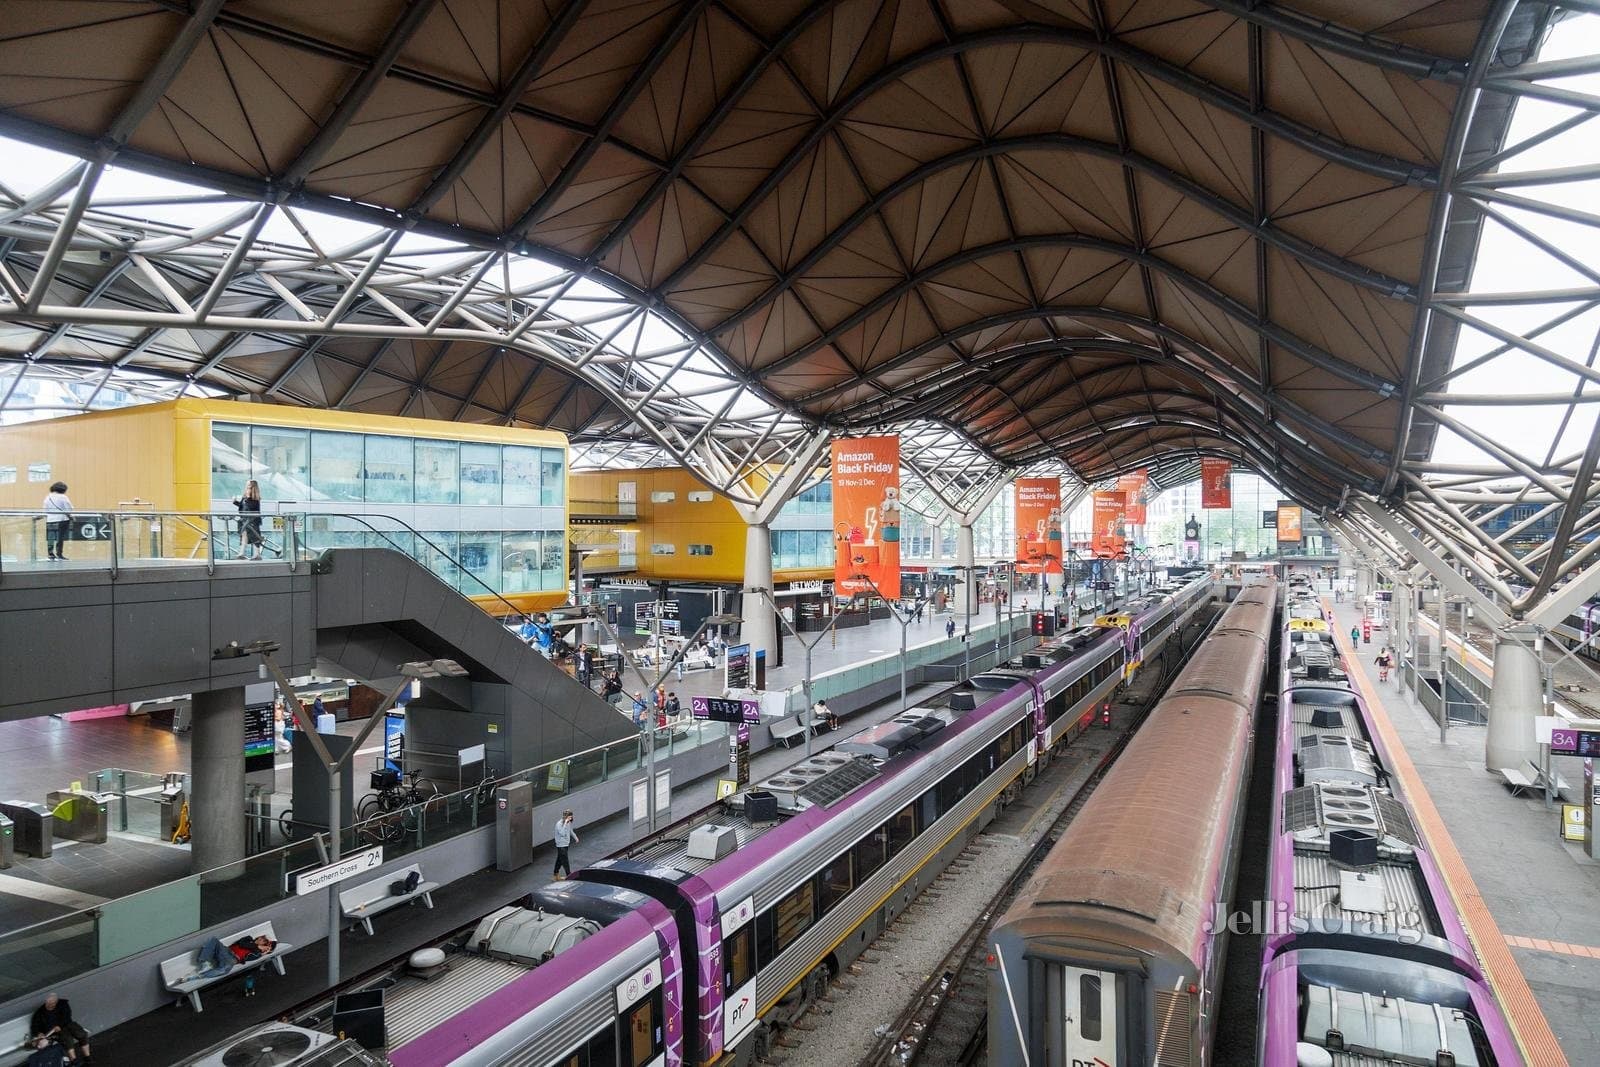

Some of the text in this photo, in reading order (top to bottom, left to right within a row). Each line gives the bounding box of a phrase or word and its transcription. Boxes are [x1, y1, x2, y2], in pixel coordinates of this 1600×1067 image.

[837, 452, 873, 462] Amazon
[837, 462, 893, 474] Black Friday
[610, 577, 649, 587] NETWORK
[790, 580, 824, 590] NETWORK
[693, 699, 709, 712] 2A
[743, 703, 759, 716] 2A
[1553, 732, 1575, 746] 3A
[308, 850, 380, 887] Southern Cross 2A
